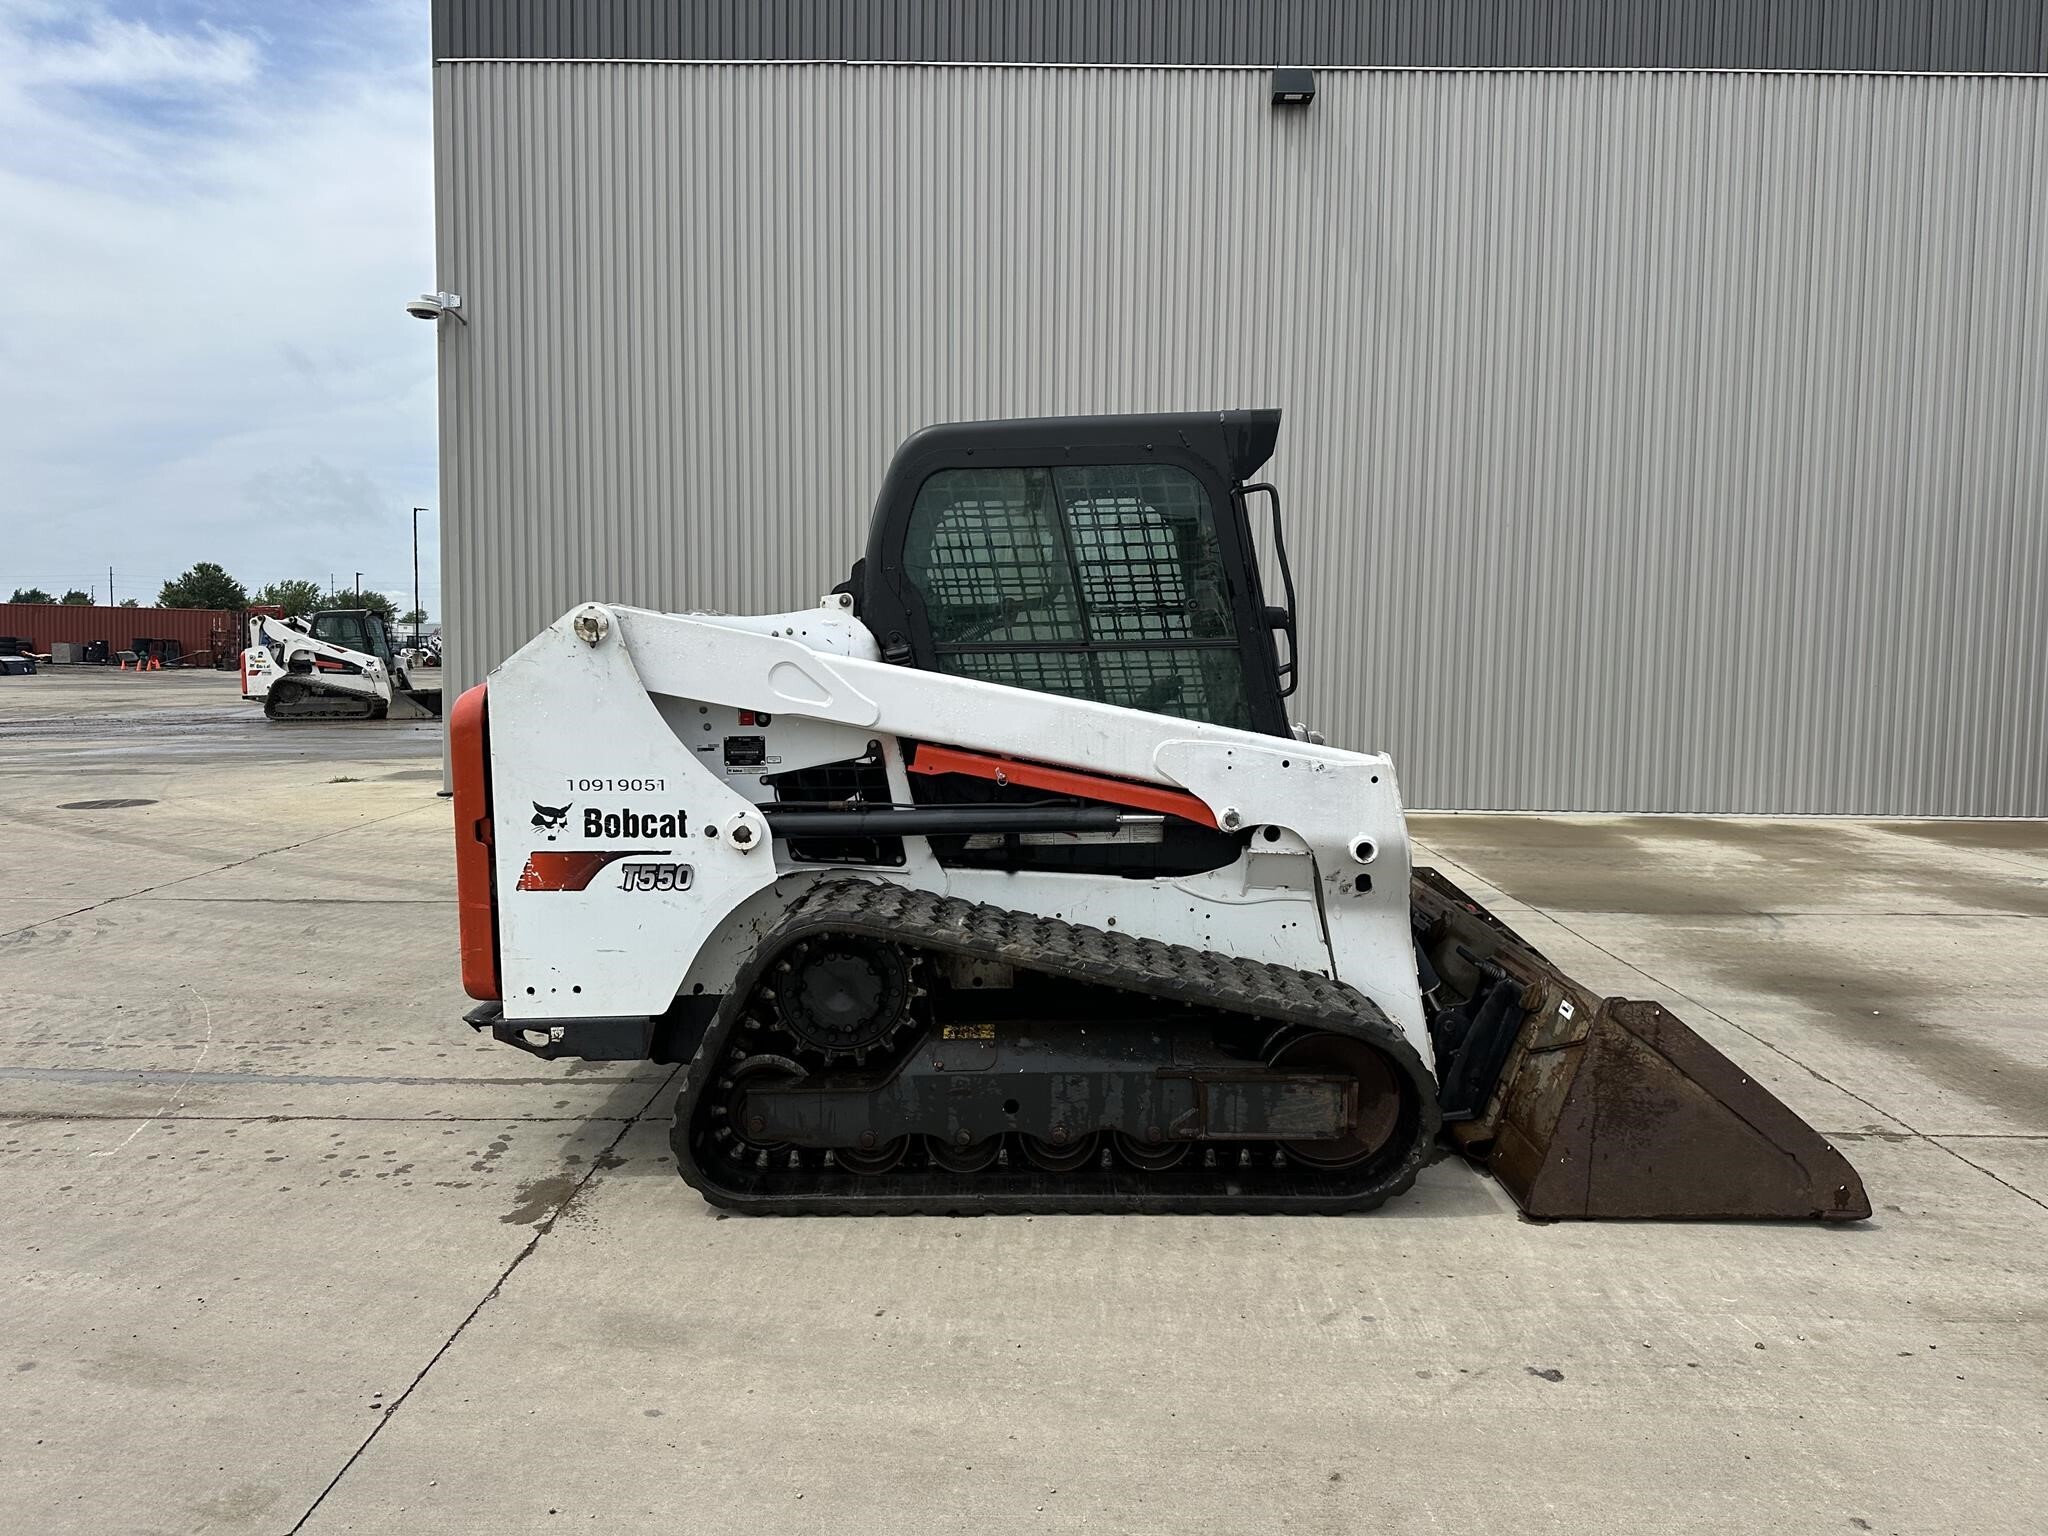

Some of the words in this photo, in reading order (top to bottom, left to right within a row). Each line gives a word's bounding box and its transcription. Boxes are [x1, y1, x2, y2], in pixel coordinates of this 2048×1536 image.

[566, 778, 665, 792] 10919051
[583, 808, 688, 838] Bobcat
[621, 863, 694, 892] T550
